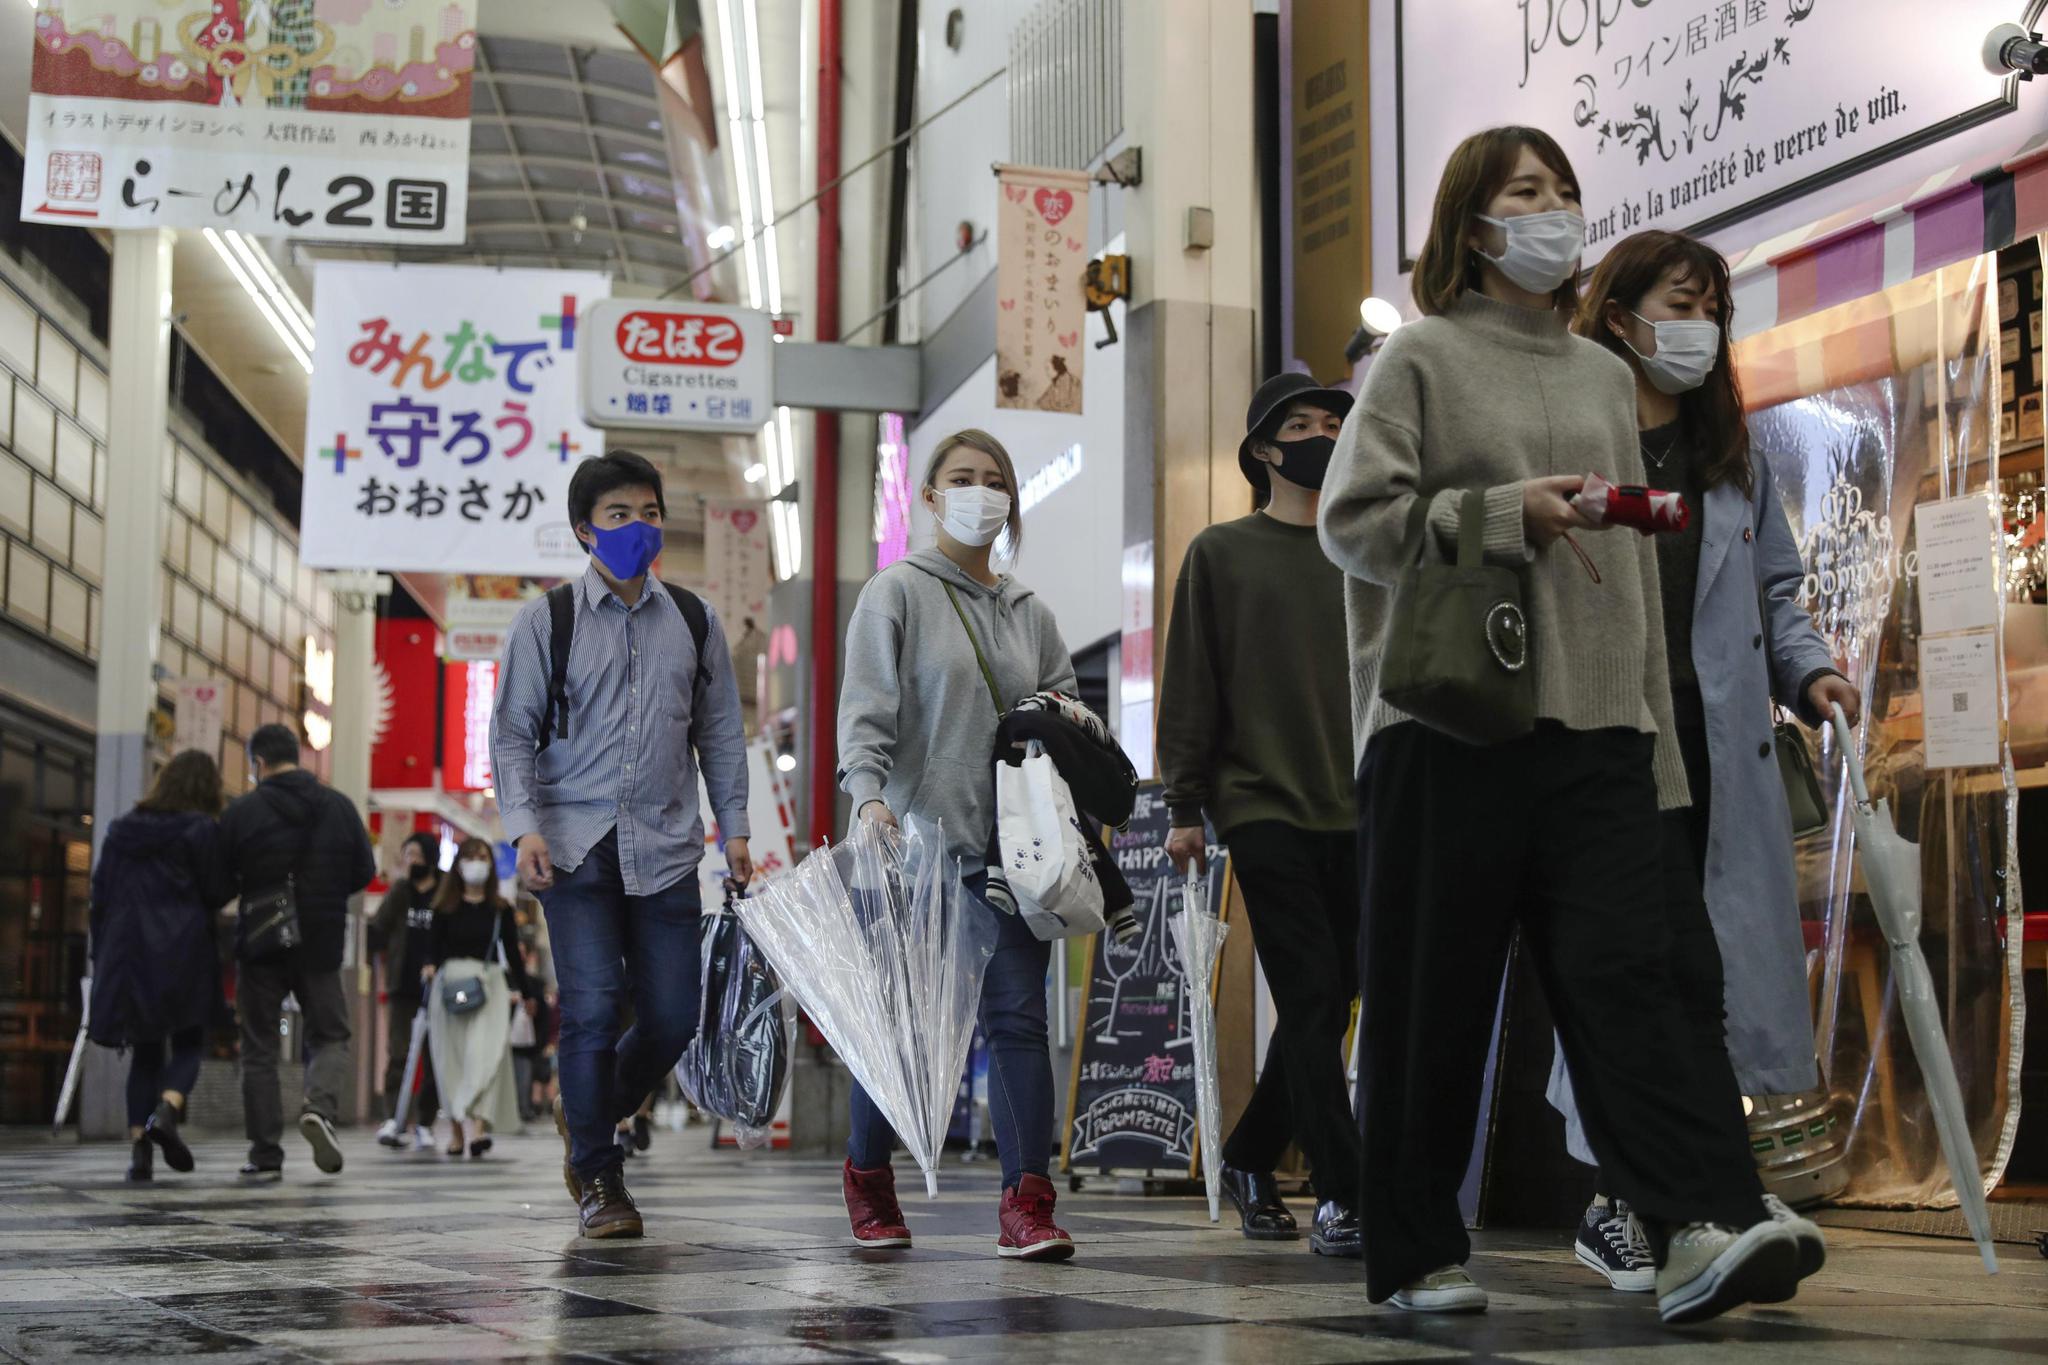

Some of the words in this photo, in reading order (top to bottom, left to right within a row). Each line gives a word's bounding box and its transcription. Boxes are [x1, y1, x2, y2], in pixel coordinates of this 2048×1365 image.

[1614, 0, 1768, 89] ワイン居酒屋
[264, 122, 337, 145] 大賞作品
[1622, 198, 1641, 232] de
[1647, 187, 1663, 220] la
[1744, 143, 1766, 178] de
[1773, 120, 1827, 166] verre
[1835, 101, 1859, 139] de
[1867, 85, 1906, 125] vin.
[347, 316, 556, 395] みんなで
[623, 315, 739, 361] たばこ
[622, 366, 738, 389] Cigarettes
[368, 395, 534, 468] 守ろう
[356, 477, 545, 522] おおさか
[1093, 1109, 1177, 1139] POPOMPETTE
